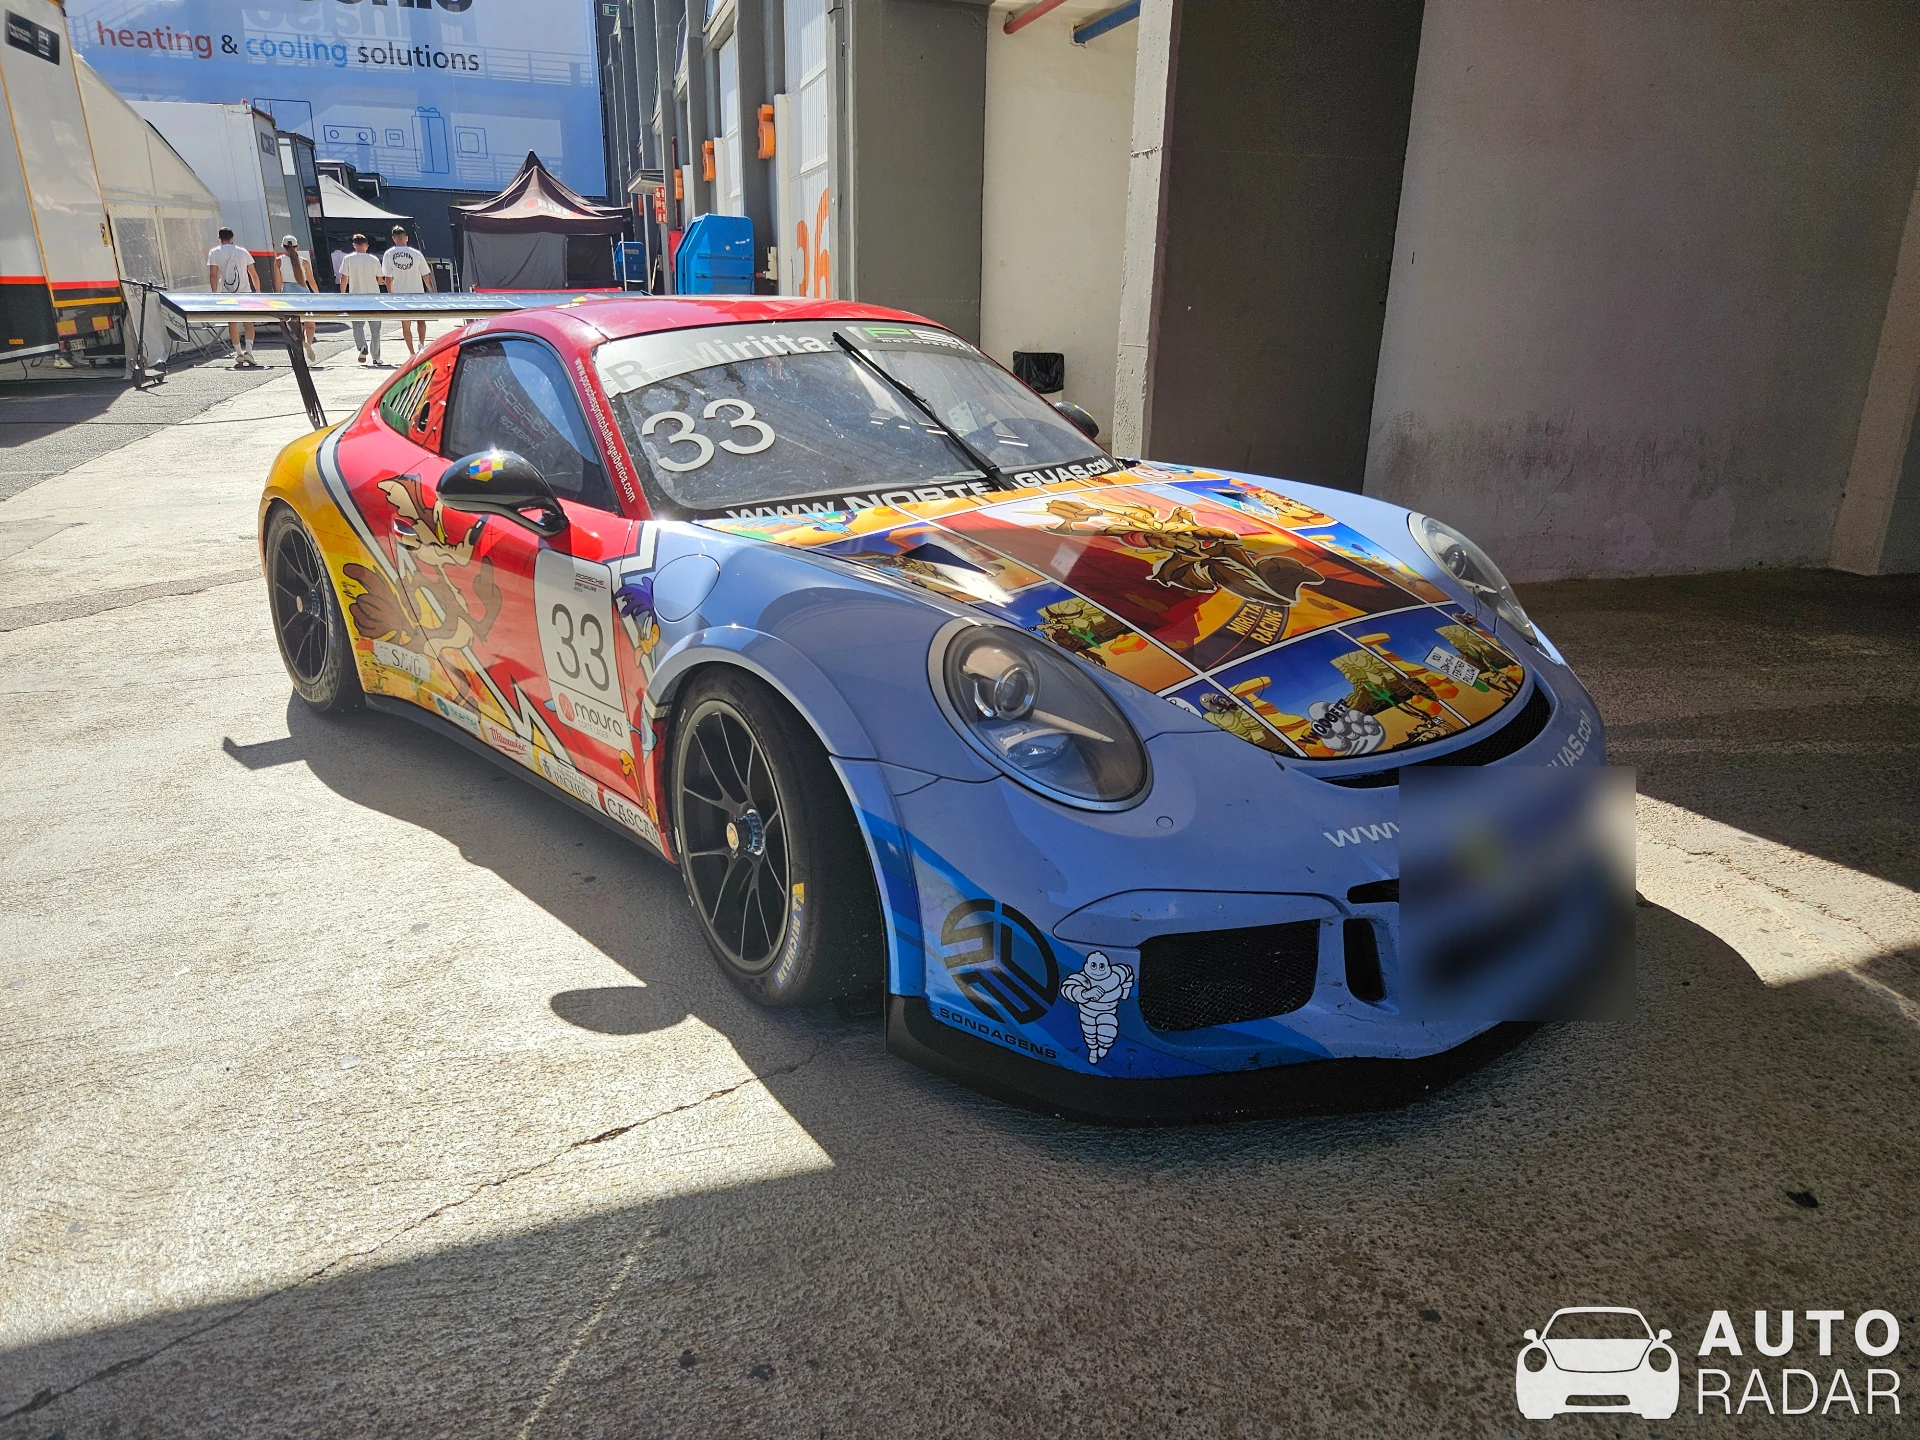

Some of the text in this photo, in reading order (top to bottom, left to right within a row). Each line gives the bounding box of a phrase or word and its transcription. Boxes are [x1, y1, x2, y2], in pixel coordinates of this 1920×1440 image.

[97, 21, 480, 71] heating & cooling solutions
[574, 357, 636, 503] www.porschesprintchallengeiberica.com
[641, 399, 776, 472] 33
[1225, 602, 1262, 637] MIRITTA
[1250, 608, 1283, 645] RACING
[552, 603, 610, 692] 33
[575, 702, 624, 738] moura
[776, 914, 801, 984] MICHELIN
[939, 1007, 1057, 1060] SONDAGENS
